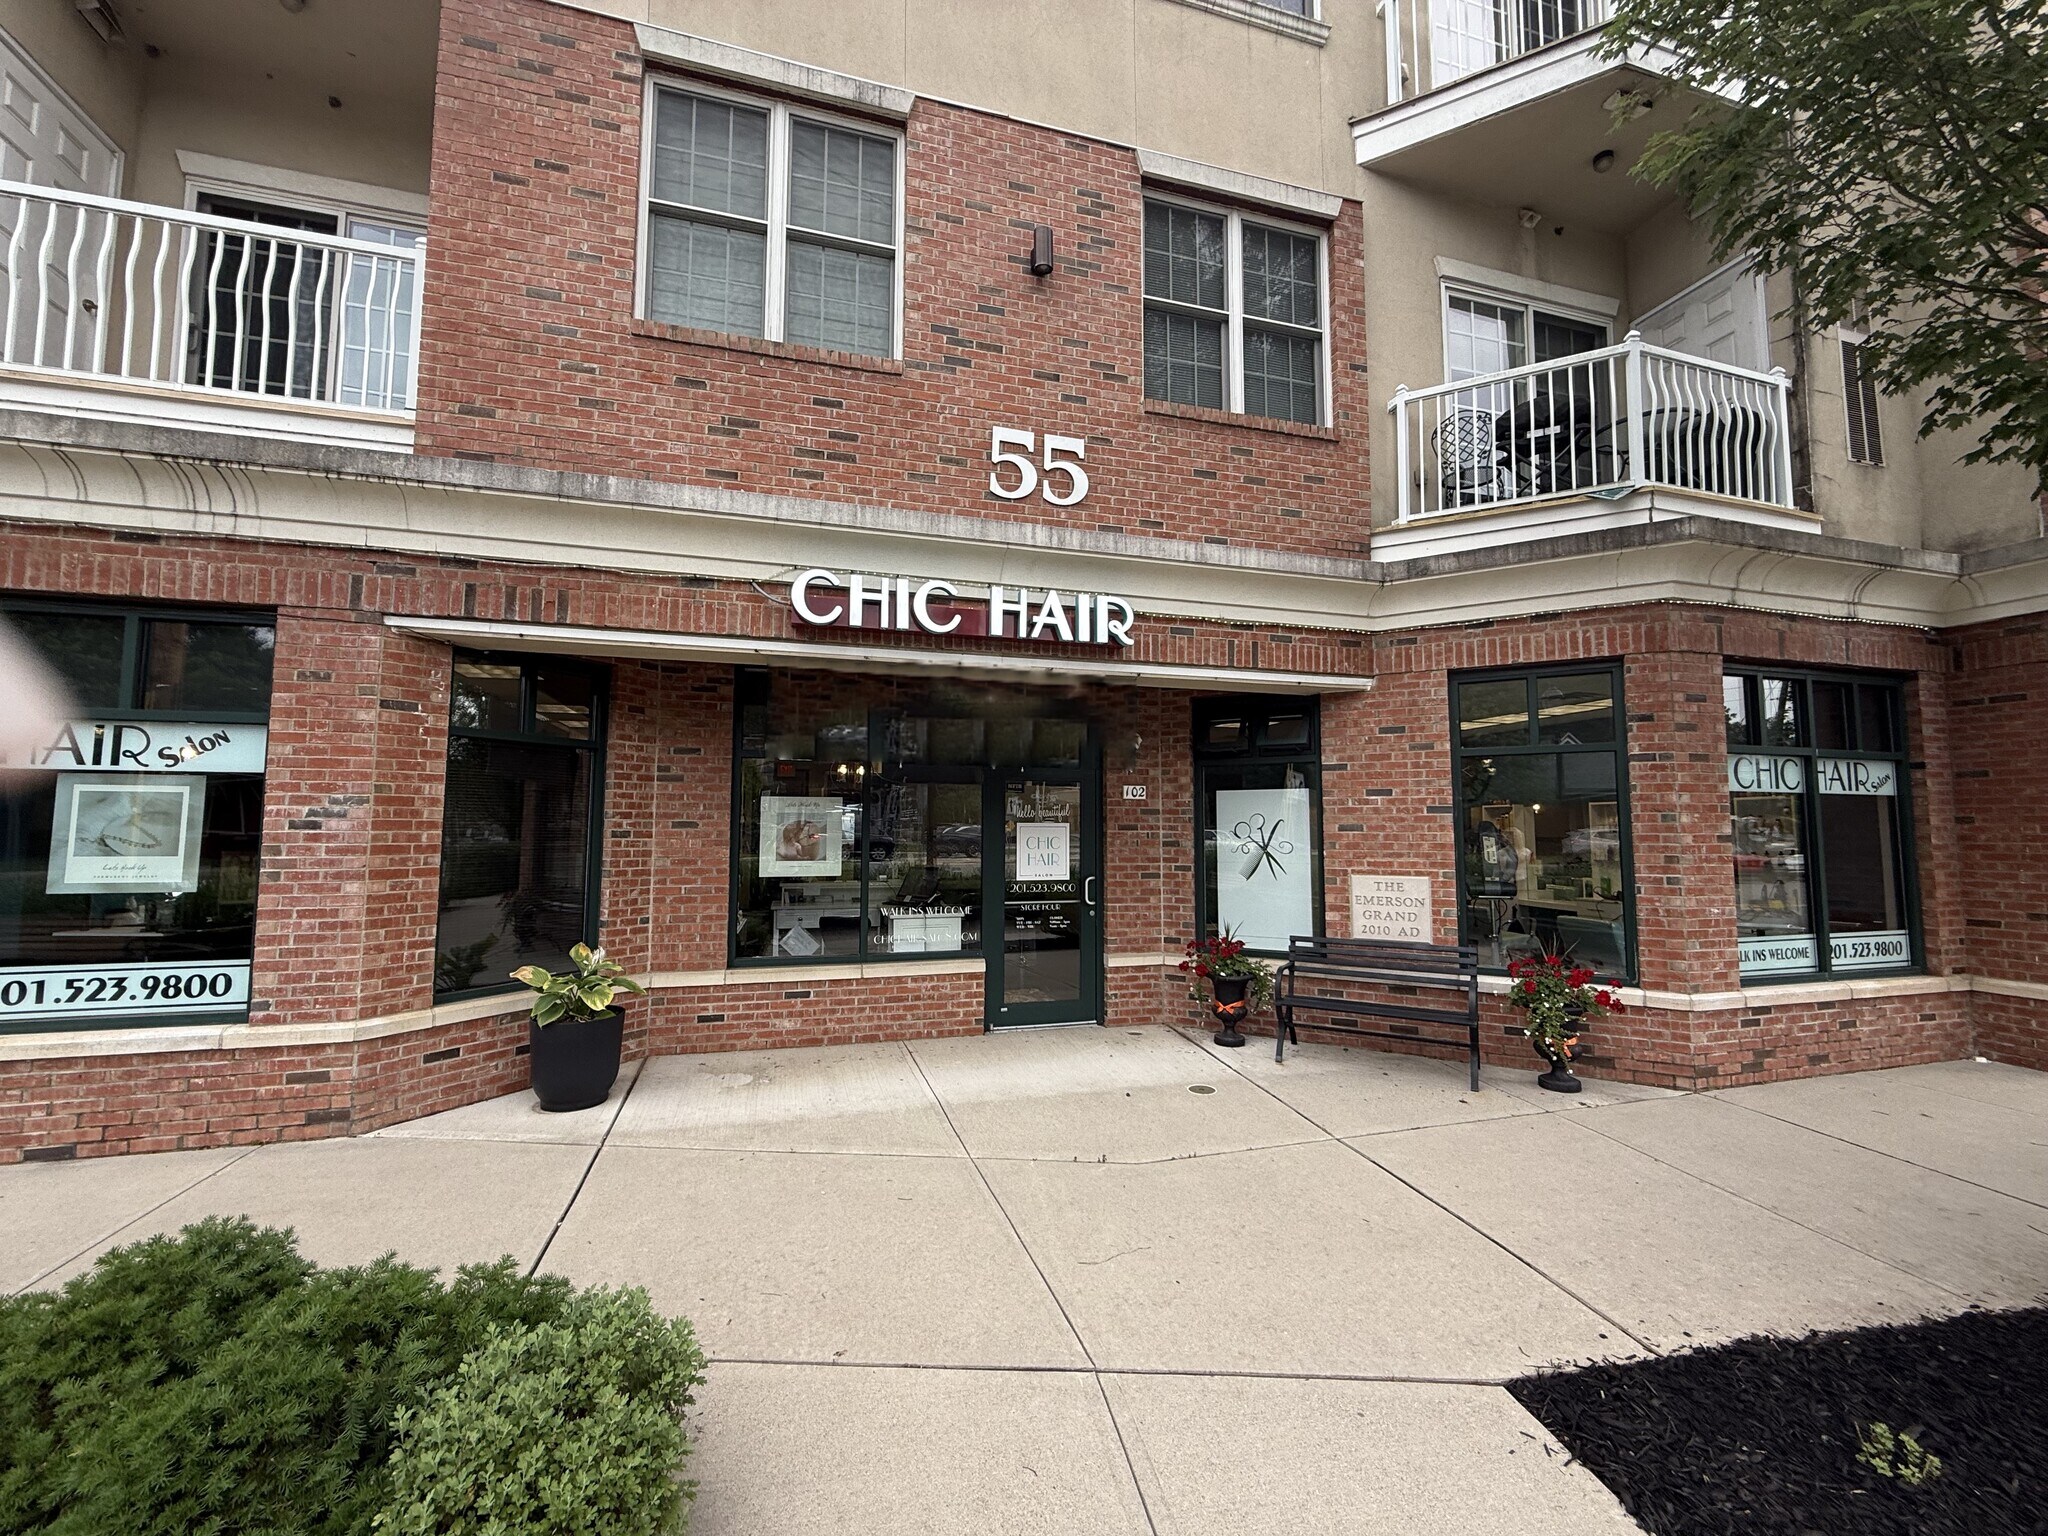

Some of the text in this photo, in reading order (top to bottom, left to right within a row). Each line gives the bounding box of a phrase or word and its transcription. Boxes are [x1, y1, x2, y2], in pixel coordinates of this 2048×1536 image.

[989, 425, 1090, 506] 55
[790, 568, 1135, 647] CHIC HAIR
[1733, 756, 1800, 791] CHIC
[1125, 786, 1145, 798] 102
[1026, 836, 1060, 850] CHIC
[1027, 853, 1060, 866] HAIR
[1009, 883, 1076, 893] 201.523.9800
[1374, 881, 1405, 892] THE
[1354, 895, 1426, 908] EMERSON
[925, 905, 973, 916] WELCOME
[1362, 910, 1418, 922] GRAND
[1361, 924, 1420, 937] 2010 AD
[1752, 949, 1767, 961] INS
[1768, 946, 1810, 960] WELCOME
[1829, 940, 1903, 960] 201.523.9800
